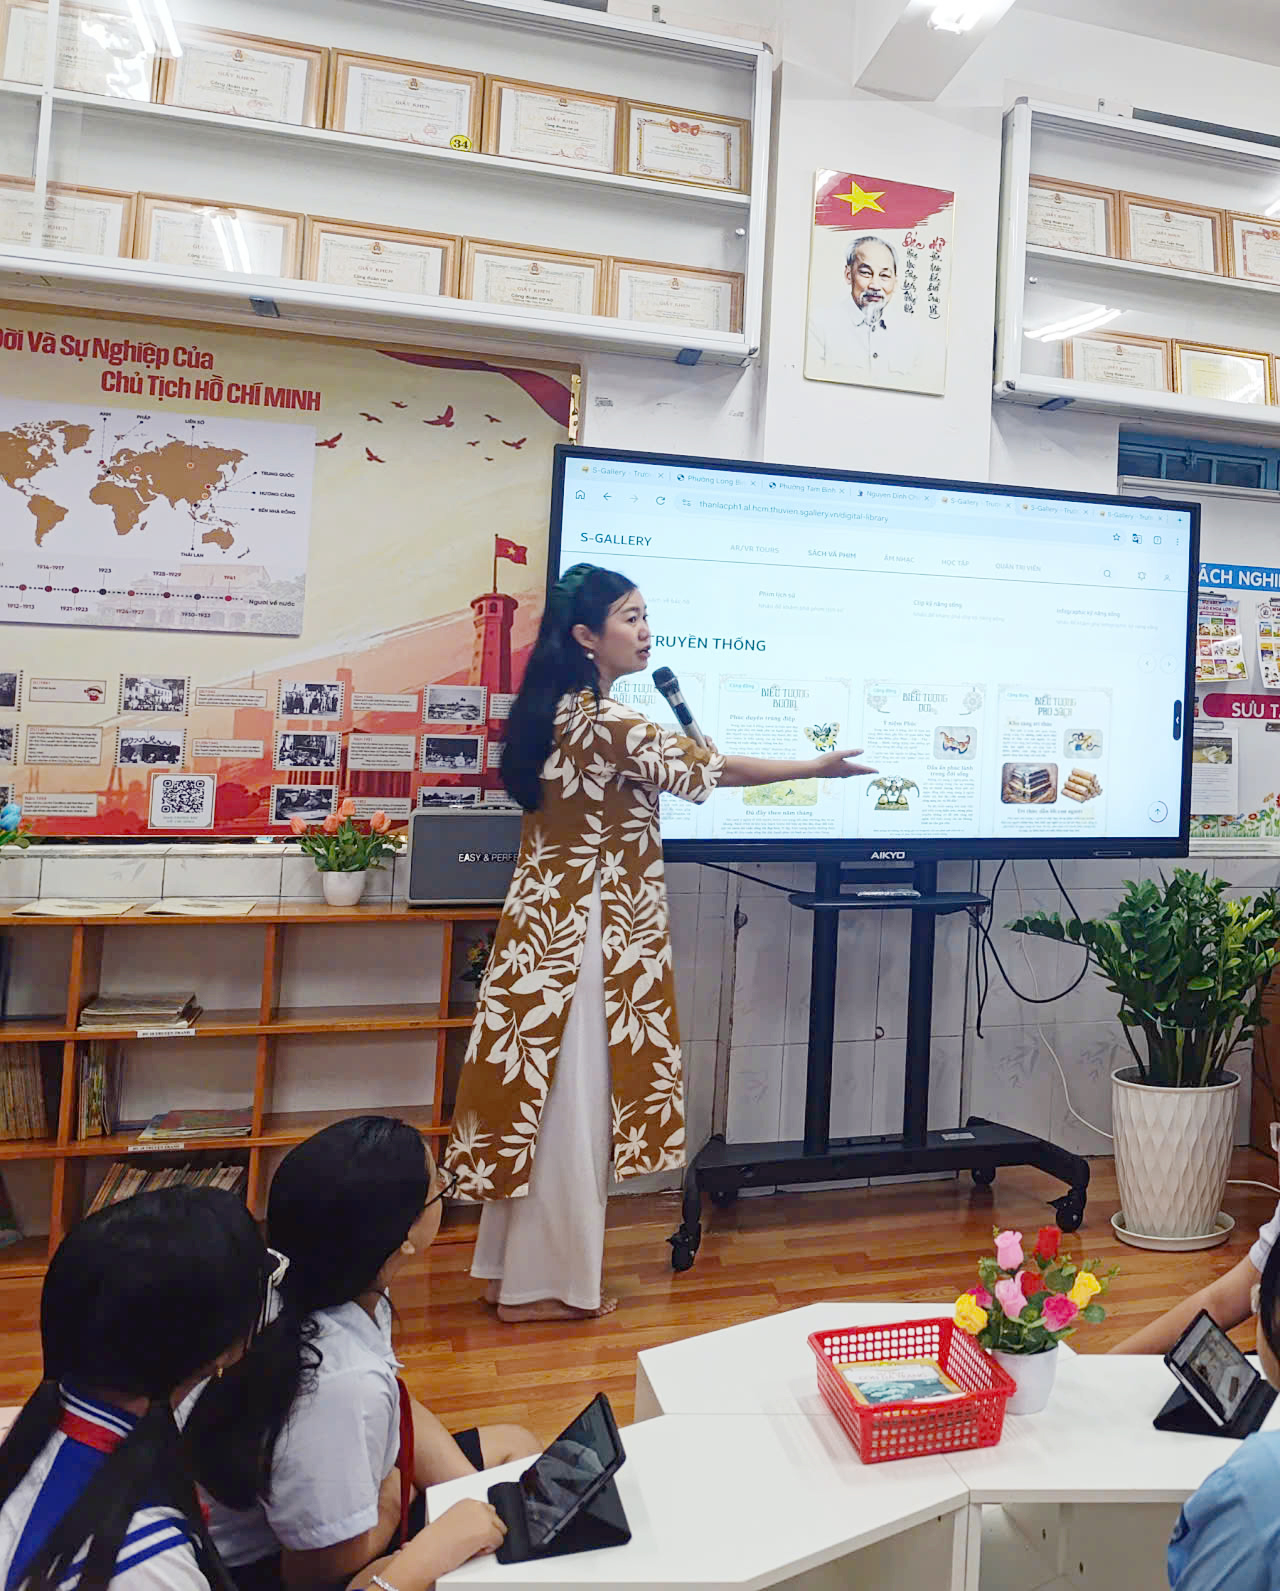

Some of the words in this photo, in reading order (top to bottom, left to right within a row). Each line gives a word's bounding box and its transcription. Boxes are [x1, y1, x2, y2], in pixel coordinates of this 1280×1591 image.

[453, 139, 469, 149] 34
[27, 331, 56, 354] Và
[60, 334, 91, 362] Sự
[93, 337, 170, 370] Nghiệp
[173, 345, 214, 370] Của
[101, 370, 143, 395] Chủ
[149, 374, 191, 402] Tịch
[195, 374, 223, 402] HỒ
[227, 382, 264, 406] CHÍ
[265, 386, 321, 412] MINH
[592, 467, 626, 478] S-Gallery
[716, 477, 734, 487] Long
[580, 532, 652, 547] S-GALLERY
[808, 549, 826, 558] SÁCH
[827, 550, 838, 558] VÀ
[1199, 564, 1232, 586] ÁCH
[651, 632, 708, 650] RUYỀN
[712, 635, 766, 651] THỐNG
[1231, 700, 1265, 718] SƯU
[458, 854, 481, 862] EASY
[484, 854, 489, 862] &
[492, 854, 519, 862] PERFE
[870, 851, 905, 860] AIKYO
